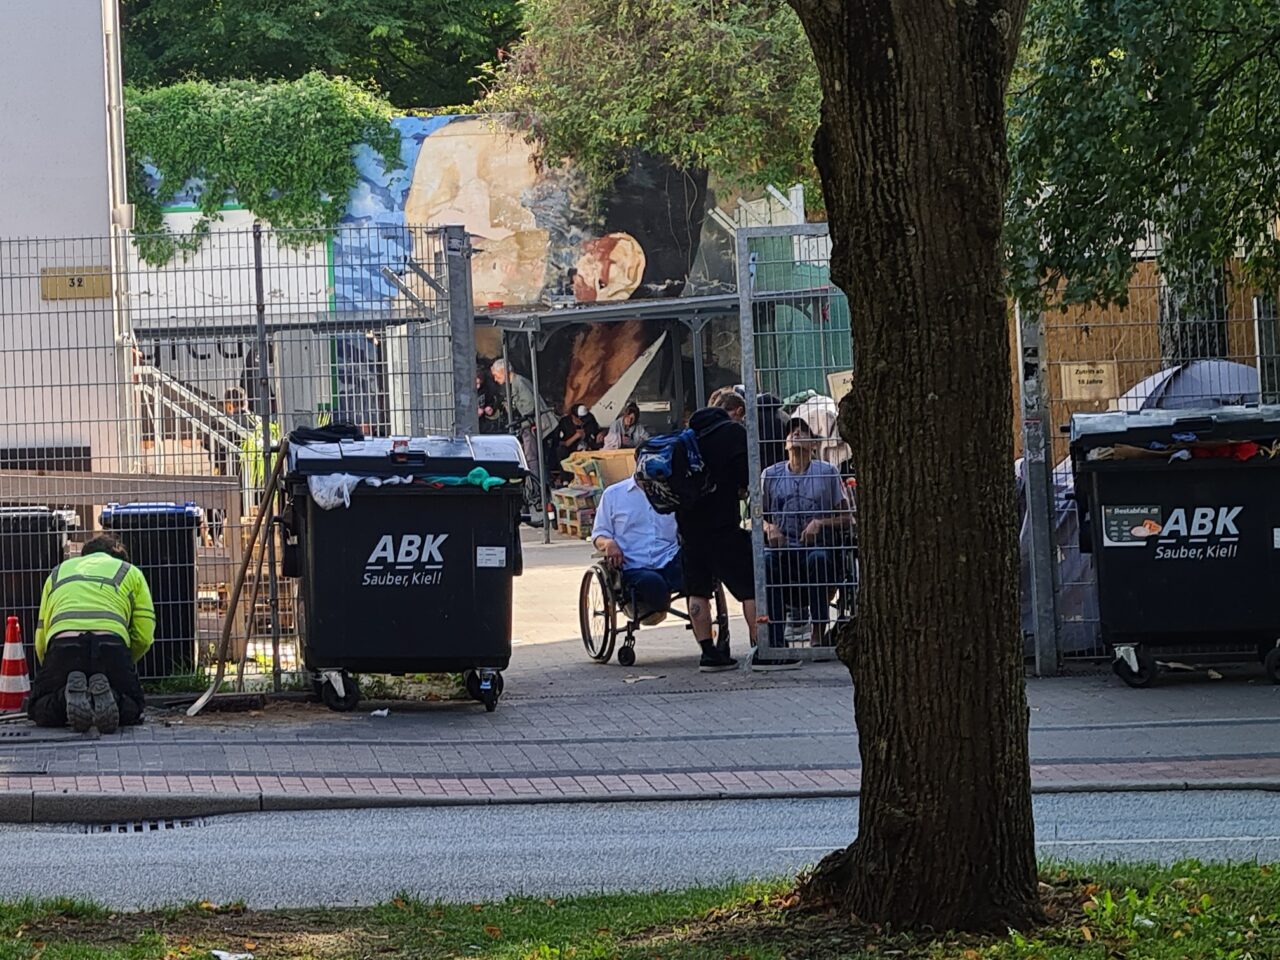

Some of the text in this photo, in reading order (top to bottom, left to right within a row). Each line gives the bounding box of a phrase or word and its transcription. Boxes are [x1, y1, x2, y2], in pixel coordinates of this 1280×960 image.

[68, 277, 84, 288] 32
[1159, 506, 1244, 537] ABK
[367, 533, 449, 563] ABK
[1154, 544, 1238, 560] Sauber, Kiel!
[361, 571, 442, 587] Sauber, Kiel!
